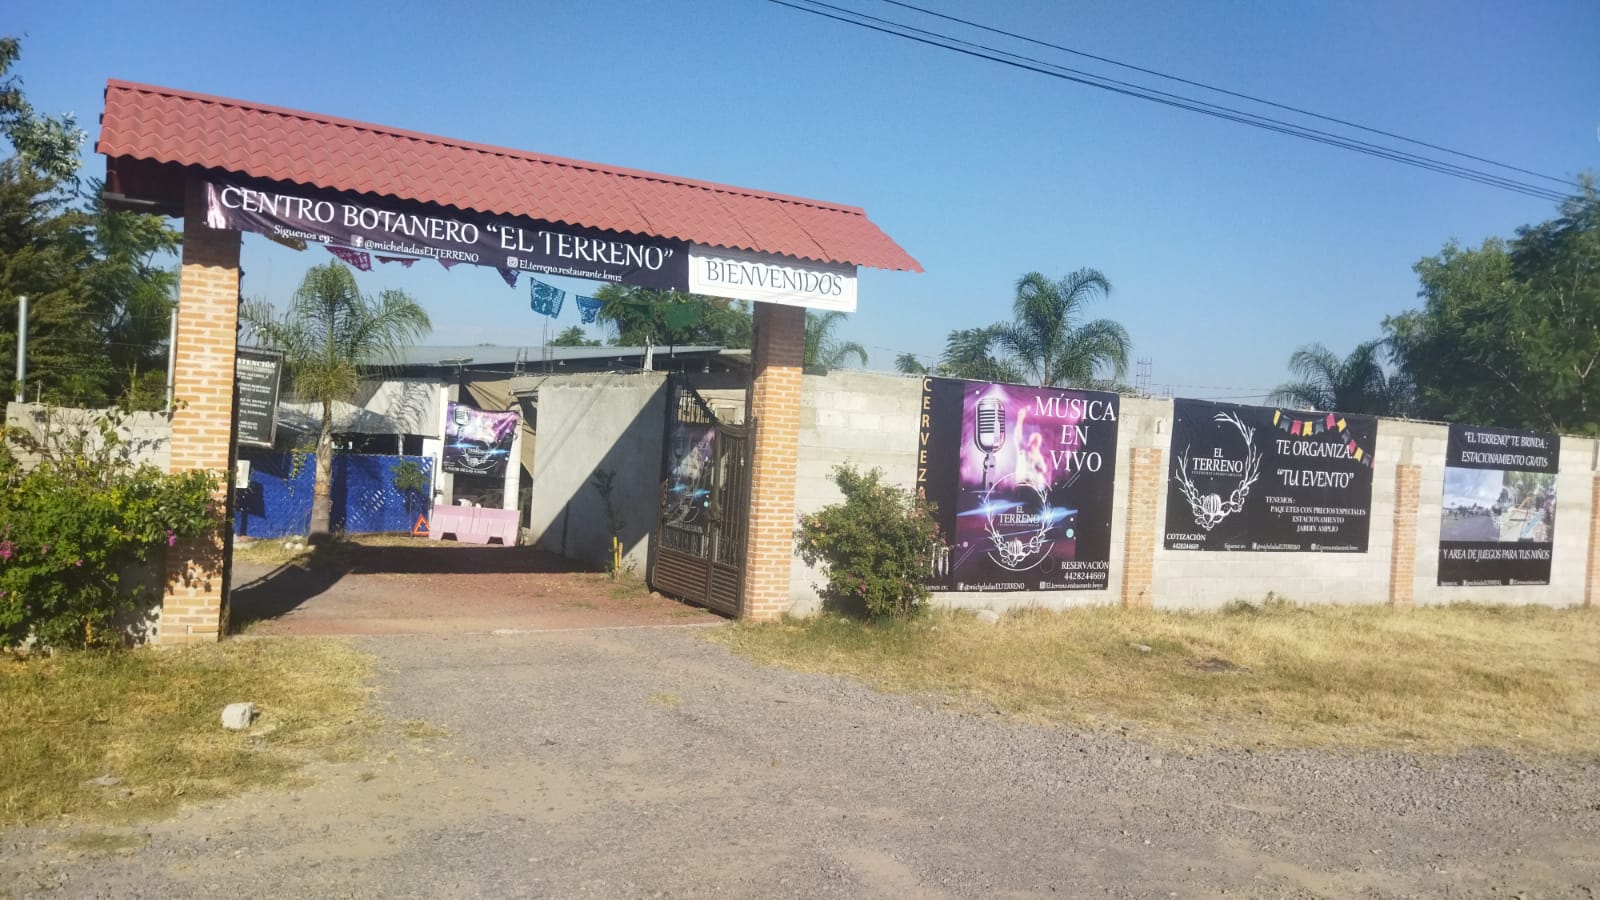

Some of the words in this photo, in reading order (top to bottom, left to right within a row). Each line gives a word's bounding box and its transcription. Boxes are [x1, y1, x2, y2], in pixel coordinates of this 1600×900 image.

[221, 185, 335, 223] CENTRO
[341, 204, 479, 244] BOTANERO
[364, 239, 479, 262] @micheladasELTERRENO
[705, 260, 843, 296] BIENVENIDOS
[1033, 393, 1117, 421] MÚSICA
[1060, 424, 1089, 446] EN
[1511, 435, 1520, 447] TE
[1213, 447, 1223, 458] EL
[1276, 439, 1291, 455] TE
[1049, 449, 1102, 473] VIVO
[1192, 457, 1244, 473] TERRENO
[1461, 451, 1525, 466] ESTACIONAMIENTO
[1525, 455, 1548, 467] GRATIS
[1016, 505, 1024, 513] EL
[1270, 505, 1300, 514] PAQUETES
[1300, 506, 1313, 514] CON
[999, 513, 1040, 524] TERRENO
[1292, 515, 1345, 524] ESTACIONAMIENTO
[1318, 525, 1339, 533] AMPLIO
[1166, 533, 1206, 542] COTIZACIÓN
[1443, 549, 1448, 559] Y
[1448, 549, 1466, 559] AREA
[1467, 549, 1477, 559] DE
[1476, 549, 1501, 563] JUEGOS
[1502, 549, 1518, 560] PARA
[1518, 549, 1531, 560] TUS
[1531, 548, 1550, 560] NIÑOS
[1061, 560, 1109, 570] RESERVACIÓN
